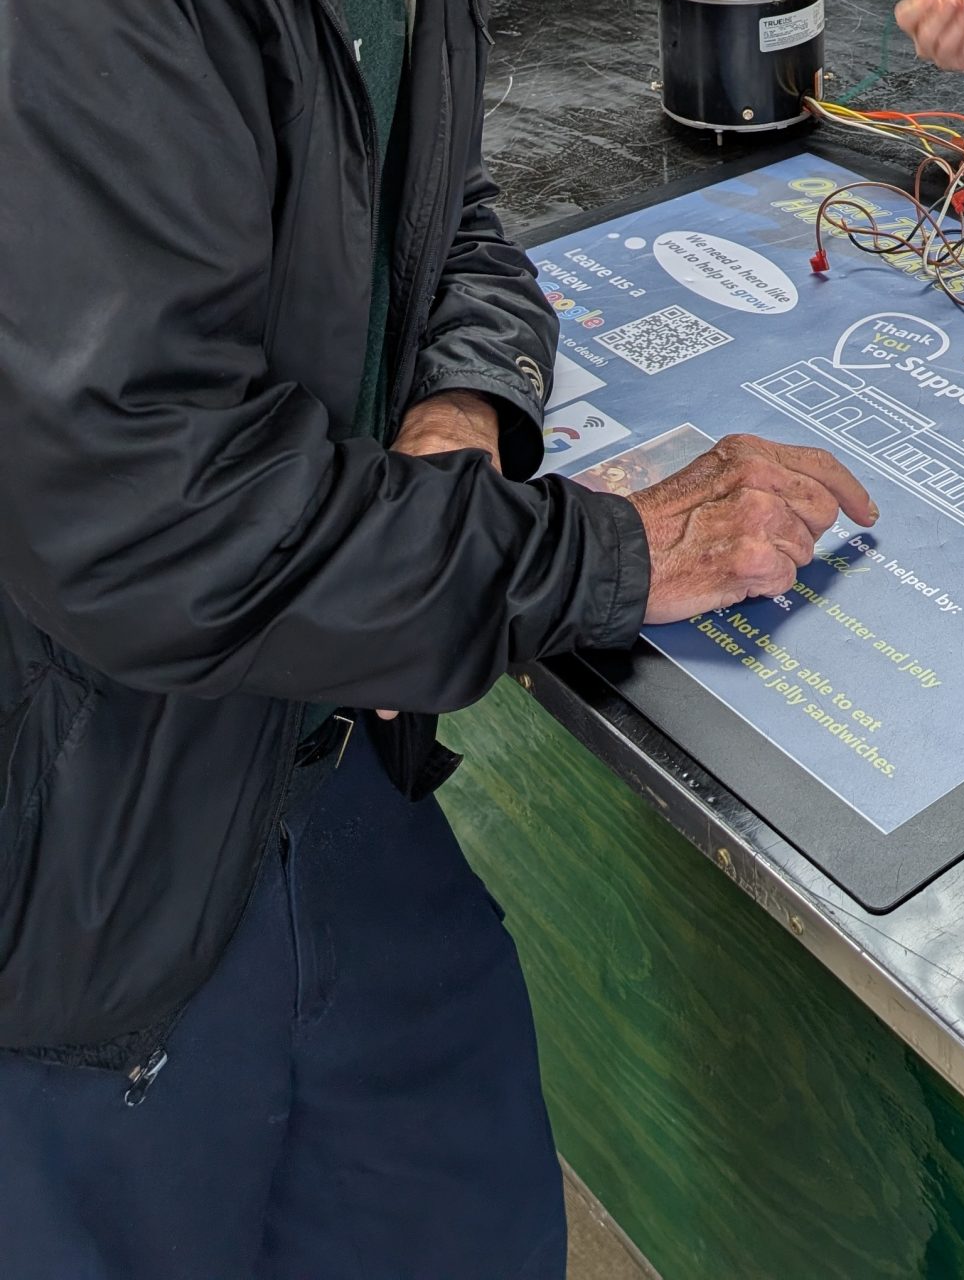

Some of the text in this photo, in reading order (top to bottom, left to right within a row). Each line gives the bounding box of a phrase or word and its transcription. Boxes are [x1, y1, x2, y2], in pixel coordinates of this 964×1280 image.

[788, 177, 892, 217] OPEN
[537, 259, 592, 293] review
[564, 247, 647, 298] Leave us a
[658, 238, 775, 315] you to help us grow!
[685, 234, 790, 304] We need a hero like
[564, 338, 609, 368] to death)
[861, 343, 899, 361] For
[872, 320, 936, 346] Thank
[873, 332, 911, 352] You
[848, 535, 886, 563] been
[884, 559, 940, 598] helped
[935, 593, 963, 615] by:
[826, 604, 876, 641] butter
[873, 639, 909, 664] and
[899, 659, 943, 689] jelly
[727, 613, 882, 732] Not being able to eat
[697, 619, 895, 779] butter and jelly sandwiches.
